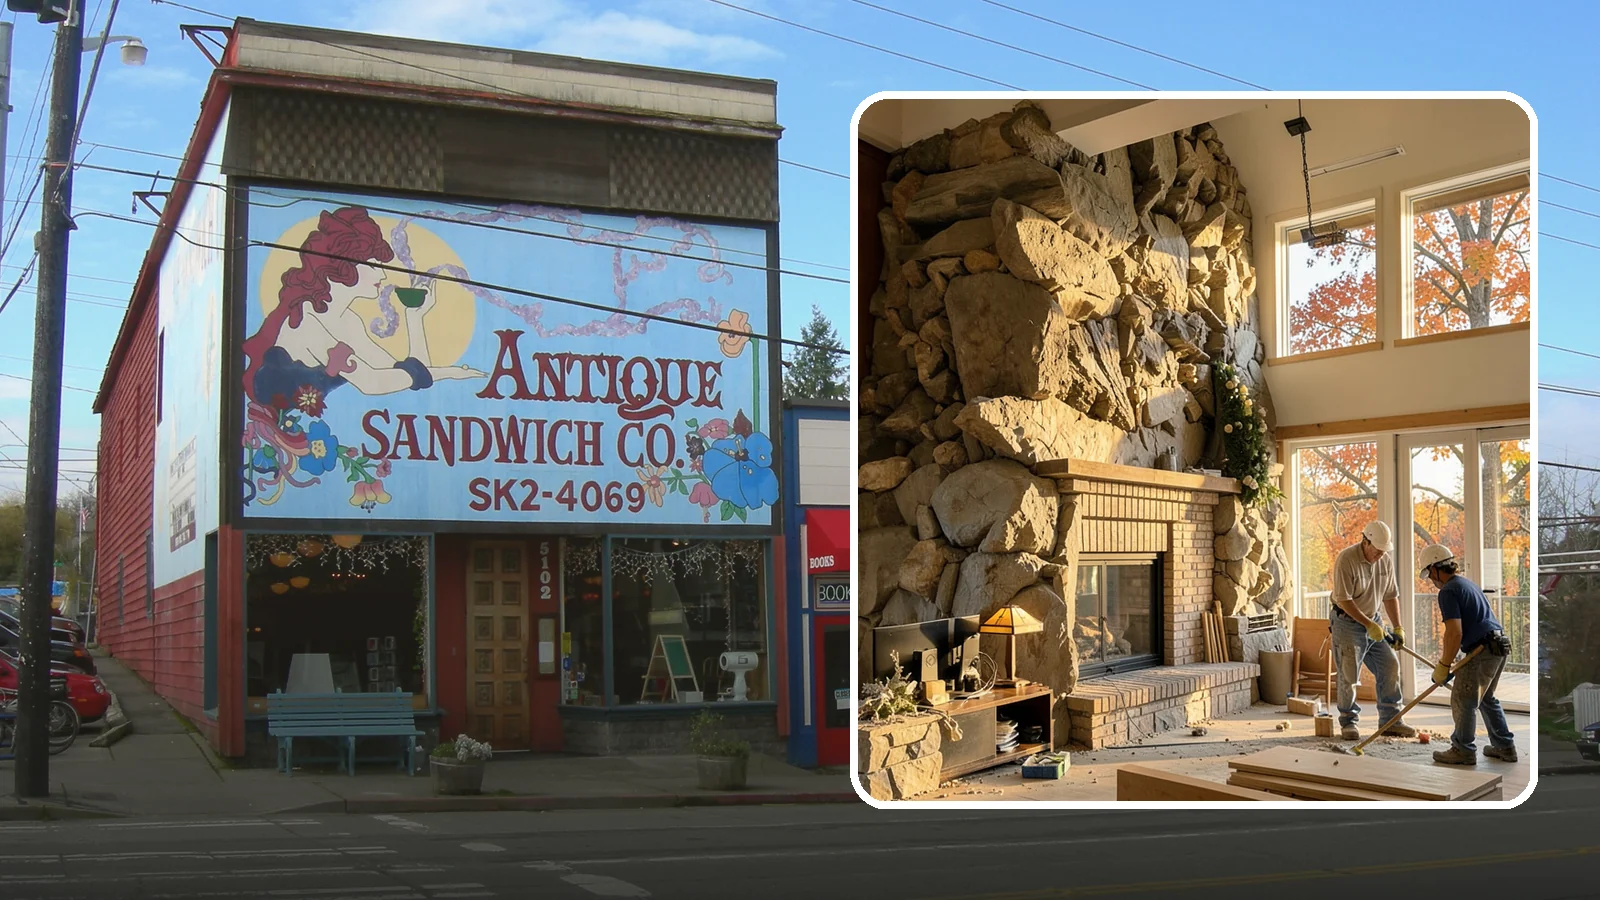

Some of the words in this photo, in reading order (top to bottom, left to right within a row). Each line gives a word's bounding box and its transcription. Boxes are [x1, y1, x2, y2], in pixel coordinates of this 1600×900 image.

[476, 329, 723, 420] ANTIQUE
[361, 409, 605, 468] SANDWICH
[617, 422, 685, 469] CO.
[468, 477, 646, 513] SK2-4069
[540, 542, 551, 599] 5102
[809, 555, 834, 569] BOOKS
